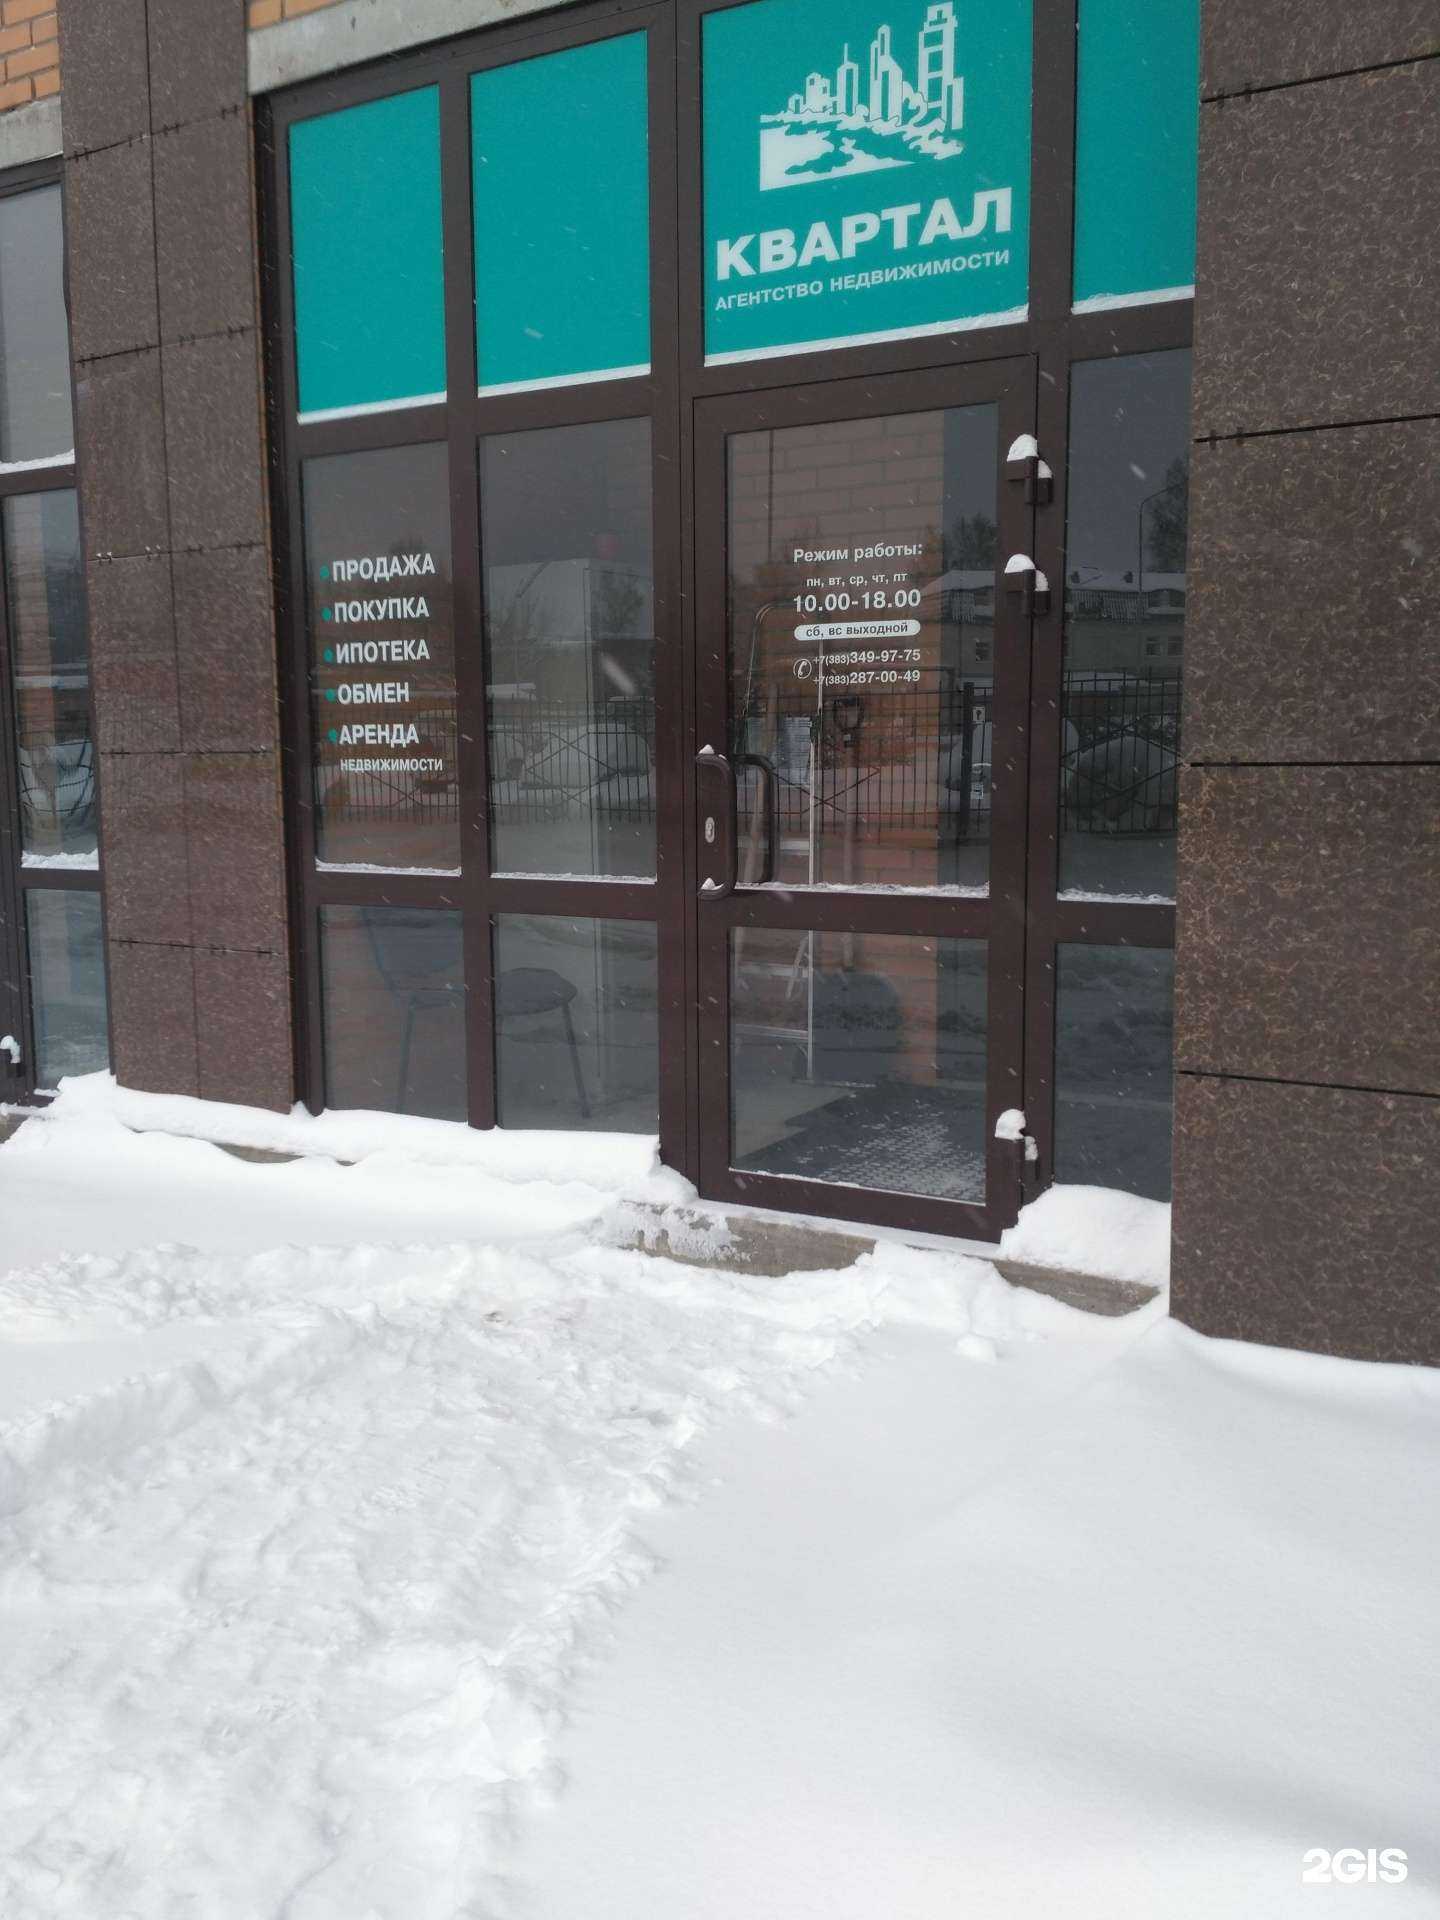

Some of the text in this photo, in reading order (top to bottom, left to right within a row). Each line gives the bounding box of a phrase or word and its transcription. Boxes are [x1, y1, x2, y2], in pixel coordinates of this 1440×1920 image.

[716, 186, 1012, 281] КВАРТАЛ
[715, 249, 1010, 311] АГЕНТСТВО НЕДВИЖИМОСТИ
[793, 542, 923, 563] Режим работы:
[332, 553, 436, 583] ПРОДАЖА
[806, 572, 908, 588] пн, вт, ср, чт, пт
[334, 597, 430, 624] ПОКУПКА
[793, 589, 921, 613] 10.00-18.00
[806, 622, 909, 638] сб, вс выходной
[336, 639, 430, 664] ИПОТЕКА
[812, 649, 921, 666] +7(383)349-97-75
[812, 670, 921, 686] +7(383)287-00-49
[337, 682, 410, 705] ОБМЕН
[339, 723, 420, 748] АРЕНДА
[340, 758, 443, 773] НЕДВИЖИМОСТИ
